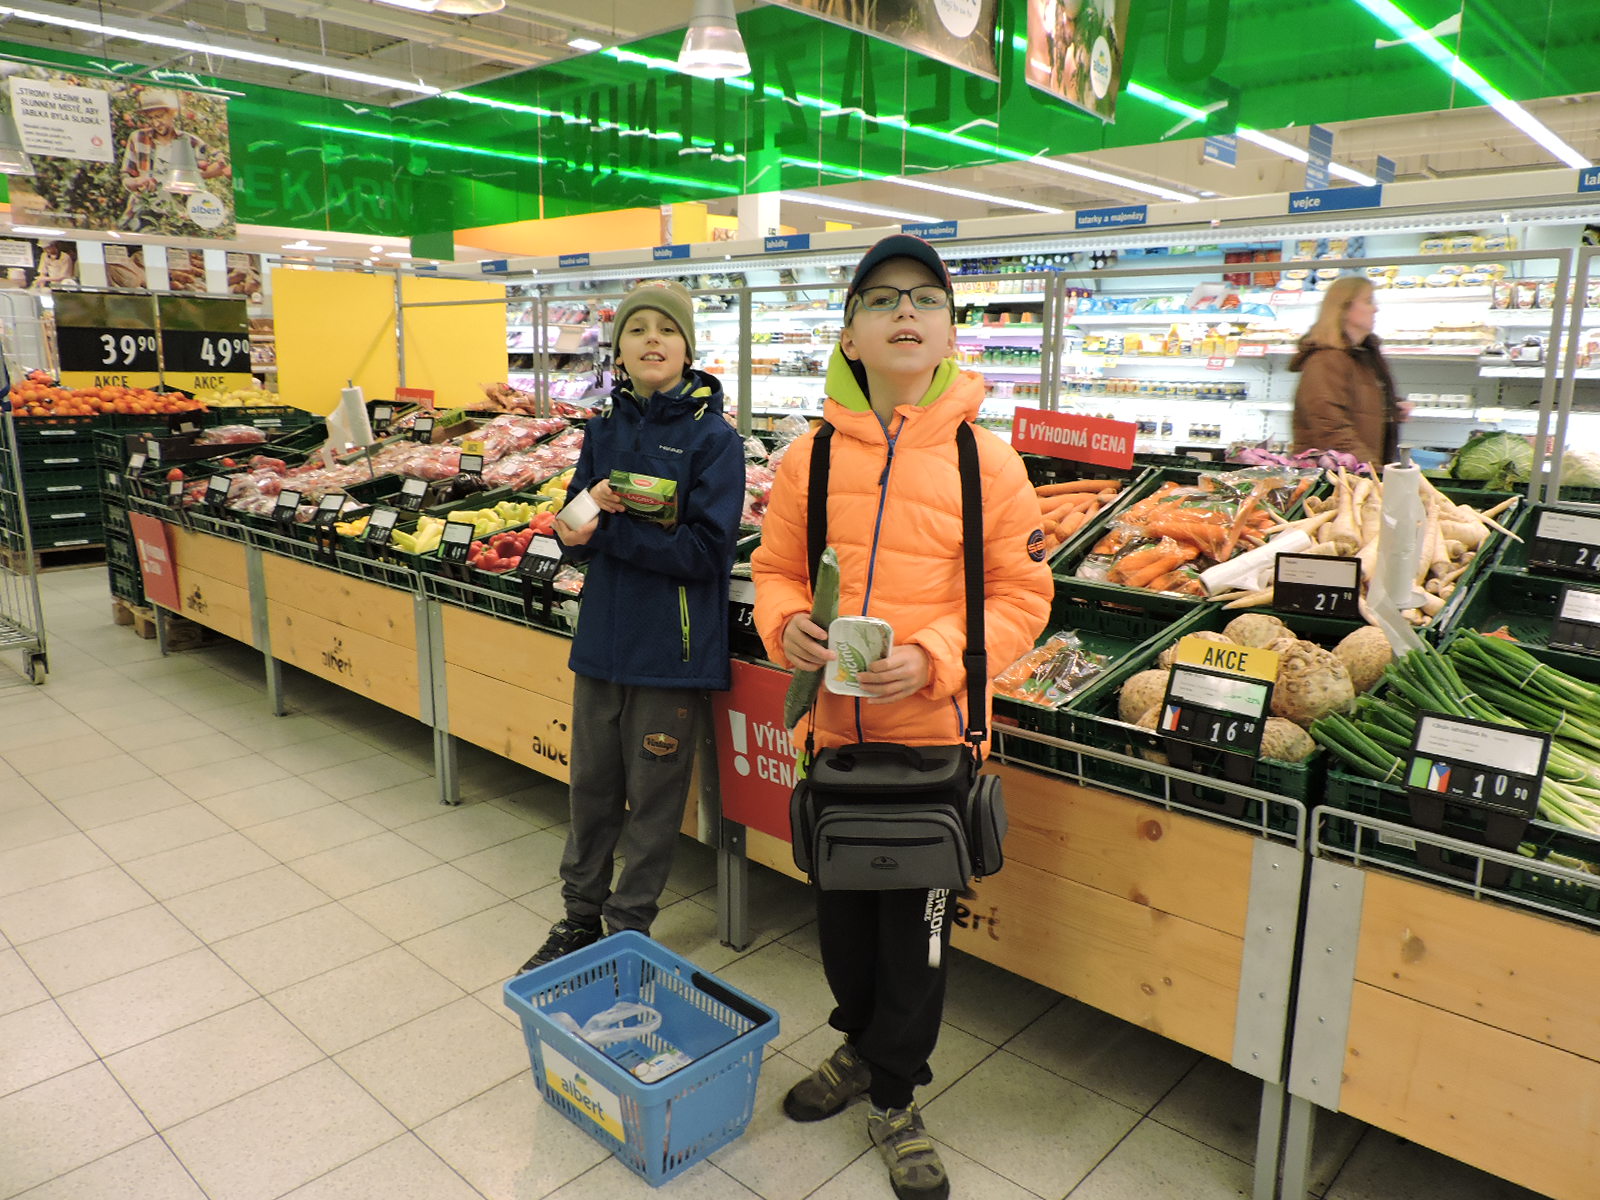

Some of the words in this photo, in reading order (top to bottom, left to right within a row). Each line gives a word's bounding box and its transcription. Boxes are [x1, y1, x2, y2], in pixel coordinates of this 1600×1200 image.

[191, 205, 221, 215] albert
[1293, 196, 1321, 209] vejce
[1078, 215, 1102, 225] tatarky
[100, 333, 137, 366] 39
[201, 337, 232, 367] 49
[1030, 421, 1088, 448] VÝHODNÁ
[1092, 433, 1126, 454] CENA
[1315, 592, 1339, 611] 27
[737, 607, 753, 626] 13
[1202, 646, 1249, 672] AKCE
[752, 721, 799, 760] VÝHO
[1209, 721, 1238, 743] 16
[1243, 722, 1256, 734] 90
[532, 735, 568, 766] albe
[1472, 773, 1508, 799] 10
[1514, 787, 1528, 801] 90
[953, 902, 1000, 941] ert
[561, 1078, 605, 1121] albert
